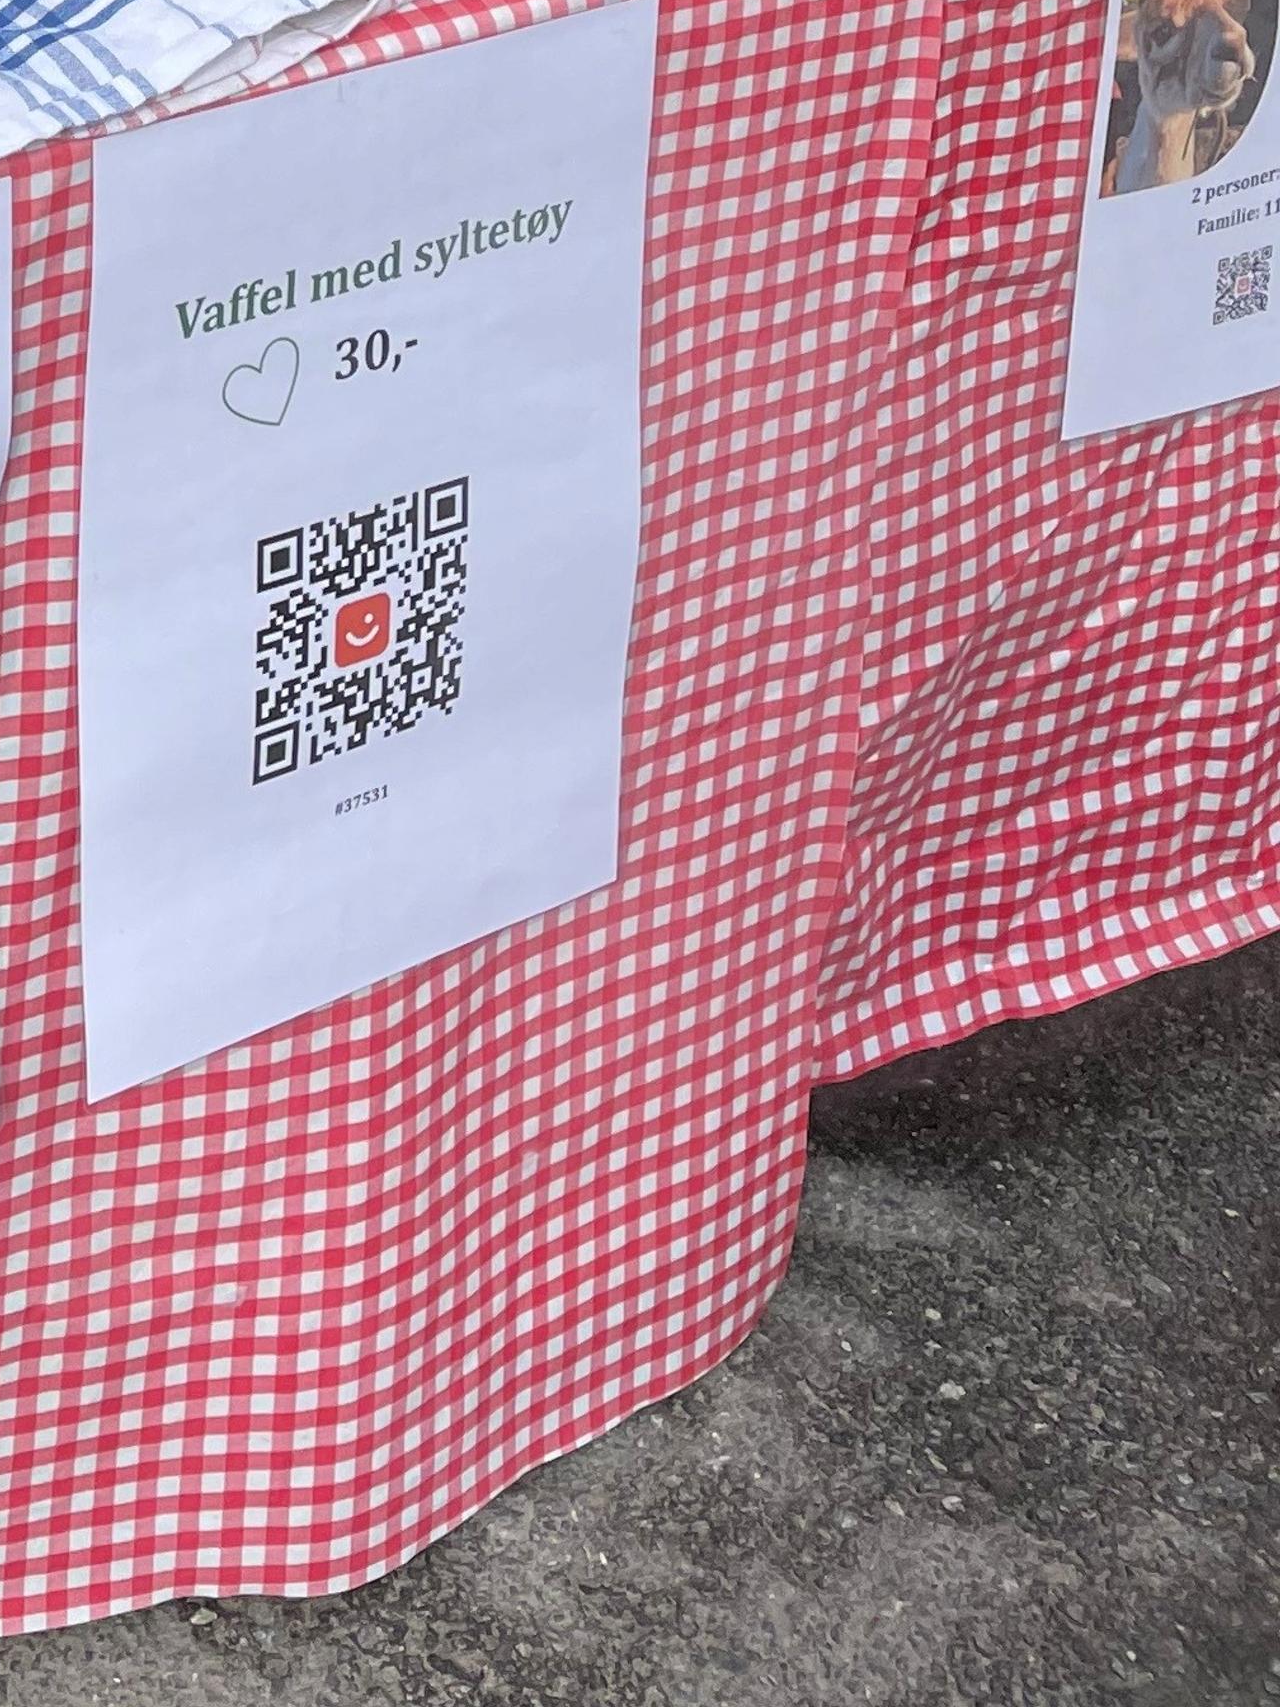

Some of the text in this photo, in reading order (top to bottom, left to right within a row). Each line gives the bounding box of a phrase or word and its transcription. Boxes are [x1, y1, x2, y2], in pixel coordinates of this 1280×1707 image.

[1192, 187, 1201, 204] 2
[1197, 207, 1260, 235] Familie:
[175, 200, 573, 339] Vaffel med syltetøy
[334, 329, 419, 381] 30,-
[334, 784, 390, 818] #37531
